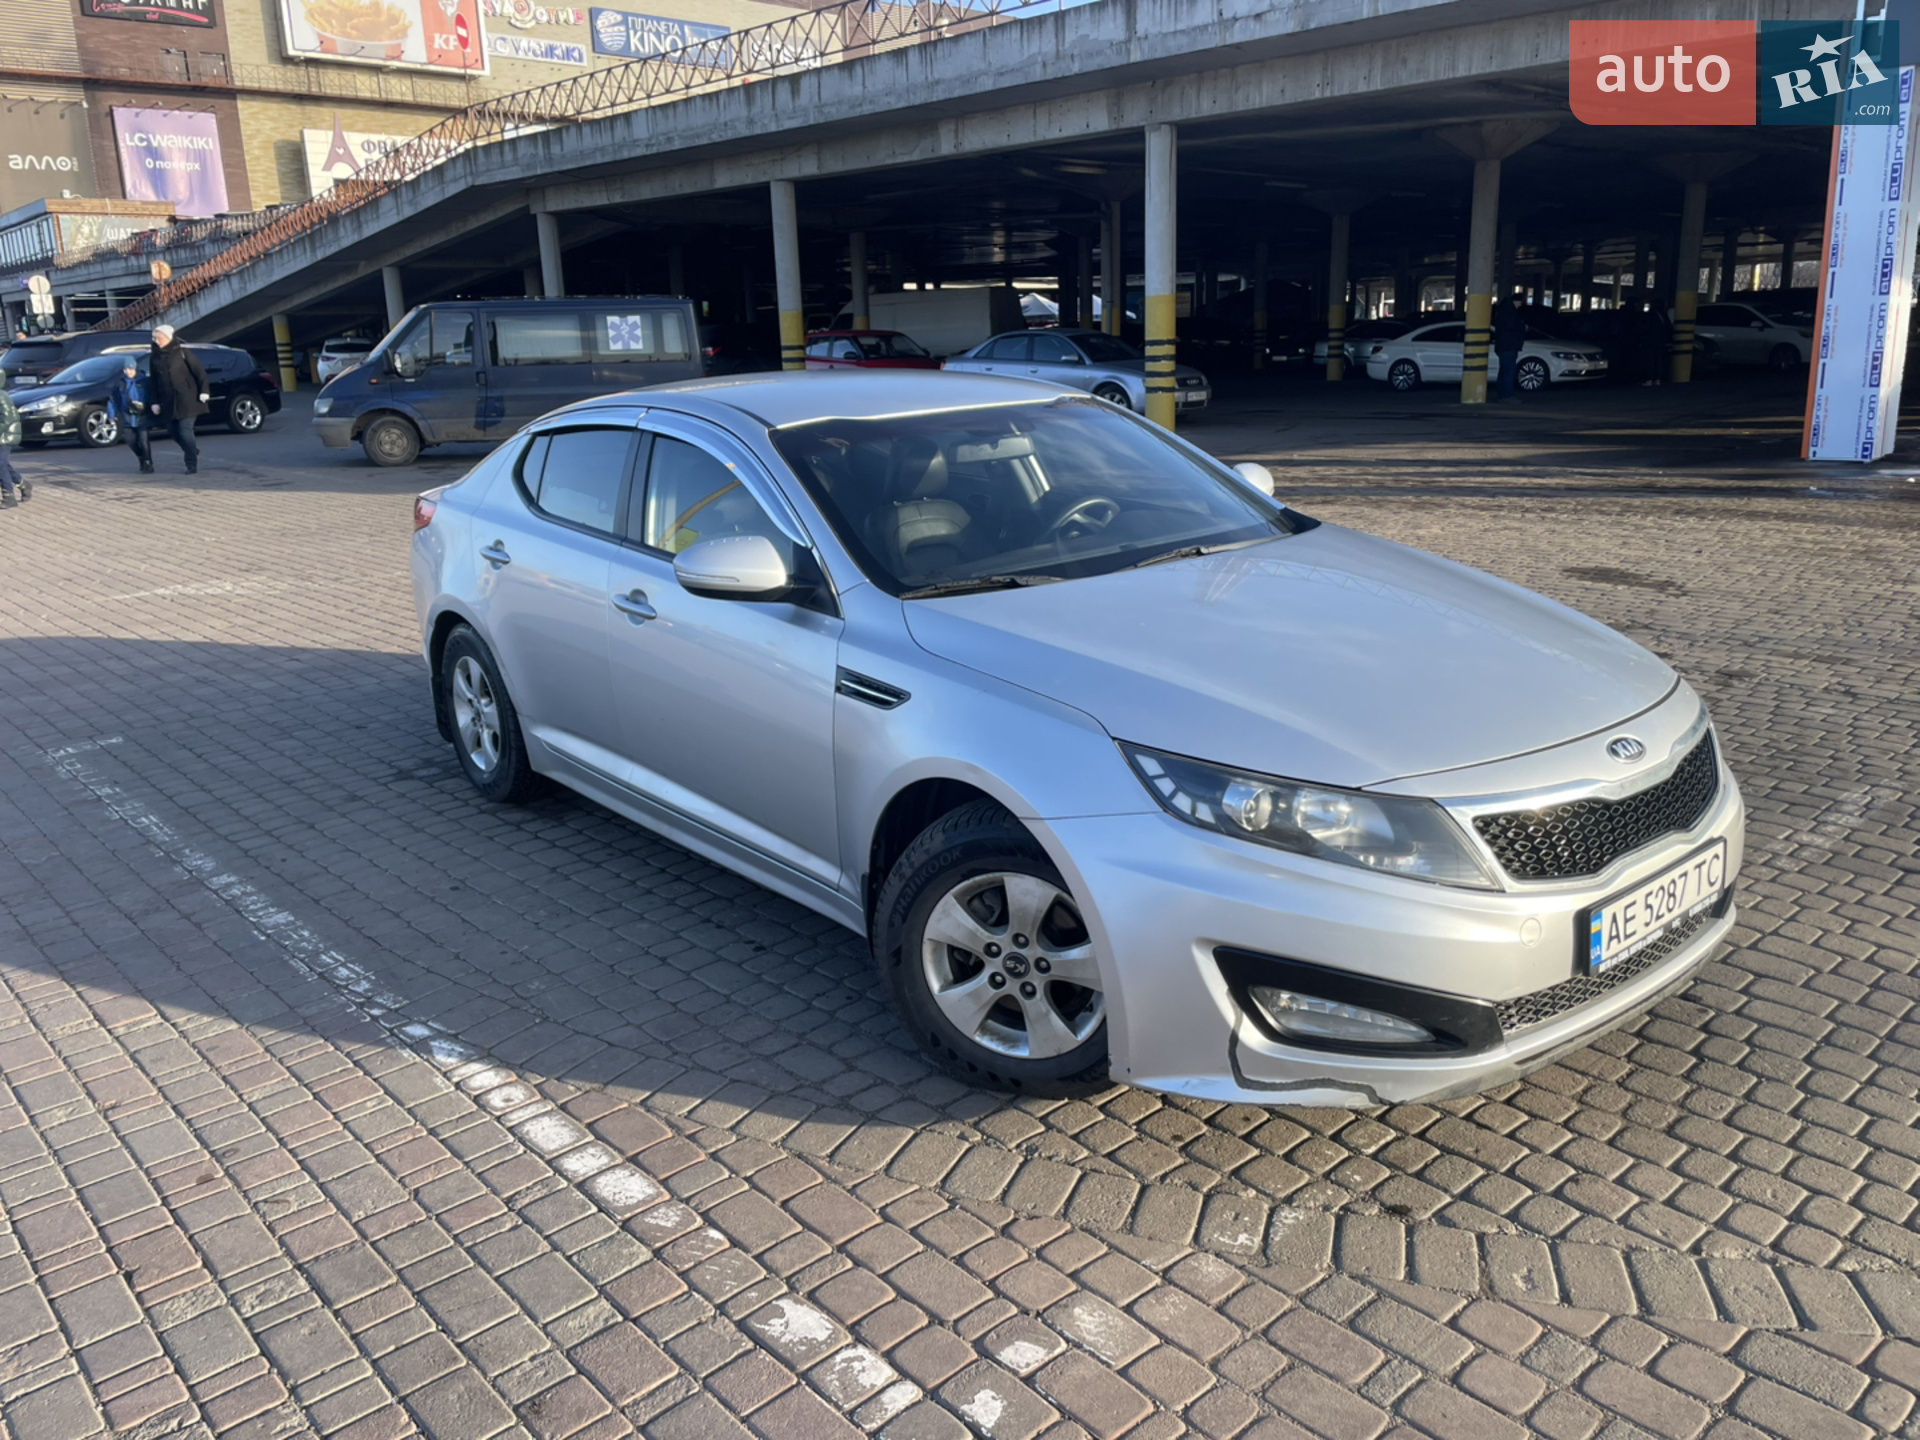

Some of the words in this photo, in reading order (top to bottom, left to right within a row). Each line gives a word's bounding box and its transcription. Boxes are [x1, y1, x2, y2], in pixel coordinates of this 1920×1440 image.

[433, 32, 472, 53] KF
[125, 132, 148, 147] LC
[145, 157, 154, 169] 0
[1606, 900, 1638, 952] AE
[1643, 870, 1689, 928] 5287
[1693, 853, 1720, 897] TC
